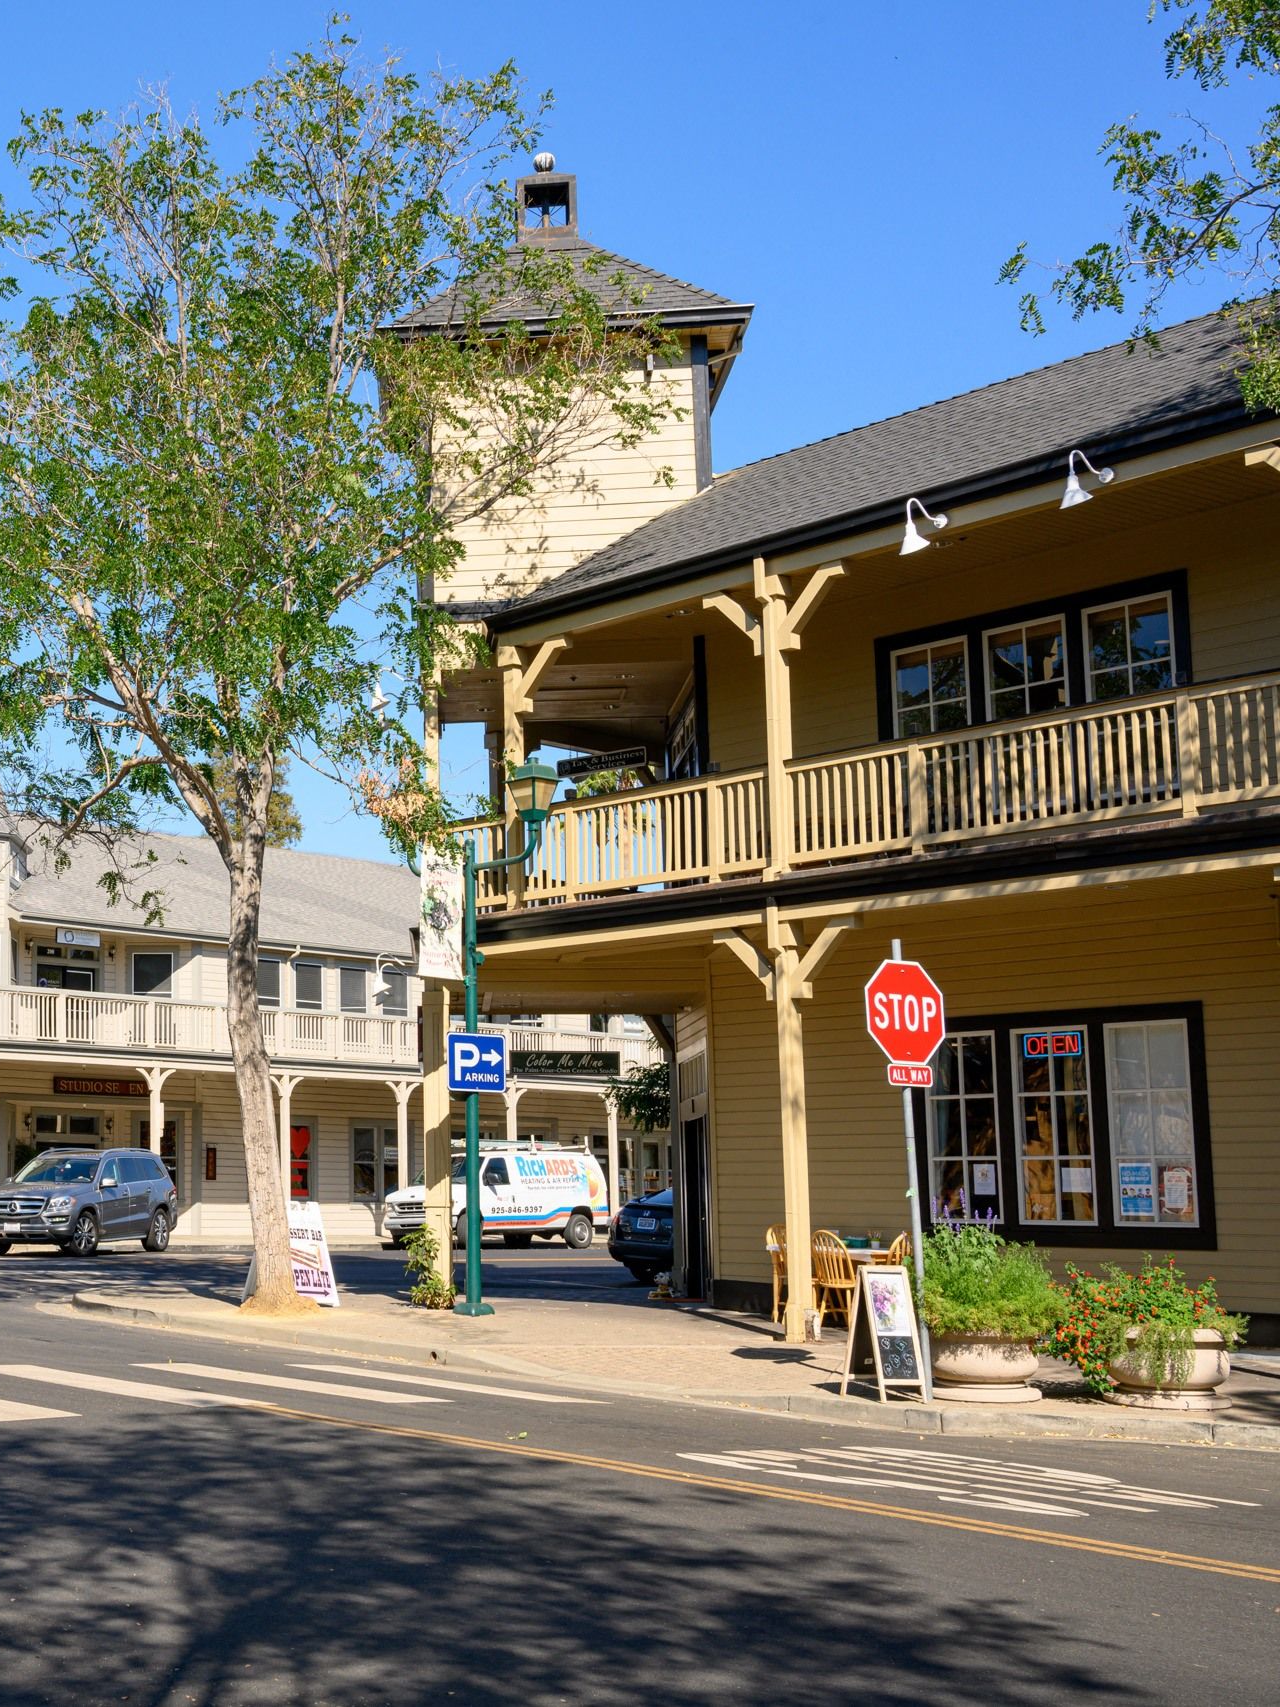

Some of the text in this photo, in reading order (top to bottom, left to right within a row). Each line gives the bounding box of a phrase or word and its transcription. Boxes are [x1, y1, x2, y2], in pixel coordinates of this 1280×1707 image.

[572, 759, 587, 767] Tax
[602, 750, 644, 762] Business
[587, 761, 626, 769] Services
[873, 992, 936, 1033] STOP
[1027, 1035, 1080, 1055] OPEN
[526, 1053, 604, 1068] Color Me Mine
[892, 1070, 929, 1083] ALL WAY
[60, 1080, 103, 1094] STUDIO
[491, 1206, 543, 1214] 925-846-9397
[290, 1228, 323, 1241] SSERT BAR
[294, 1269, 331, 1288] PEN LATE
